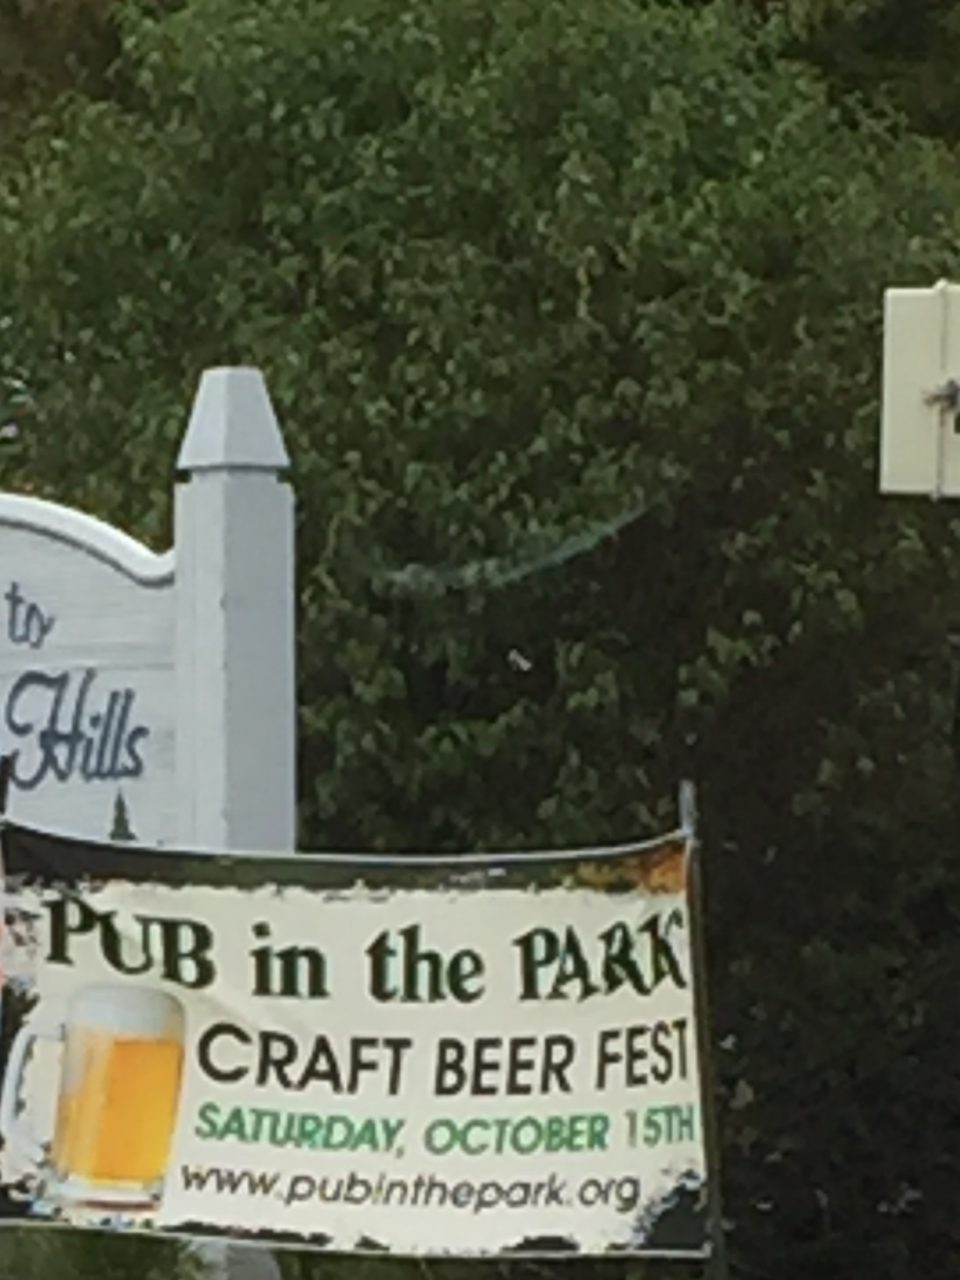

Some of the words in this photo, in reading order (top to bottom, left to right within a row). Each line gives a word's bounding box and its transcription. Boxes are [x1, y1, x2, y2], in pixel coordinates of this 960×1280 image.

[4, 582, 55, 650] to
[4, 667, 149, 790] Hills
[41, 892, 216, 989] PUB
[249, 921, 330, 999] in
[366, 922, 485, 1003] the
[512, 908, 687, 1001] PARK
[198, 1022, 412, 1096] CRAFT
[434, 1034, 575, 1096] BEER
[596, 1017, 687, 1089] FEST
[195, 1102, 405, 1158] SATURDAY,
[424, 1113, 610, 1155] OCTOBER
[626, 1104, 695, 1147] 15TH
[181, 1165, 640, 1213] www.pubinthepark.org
